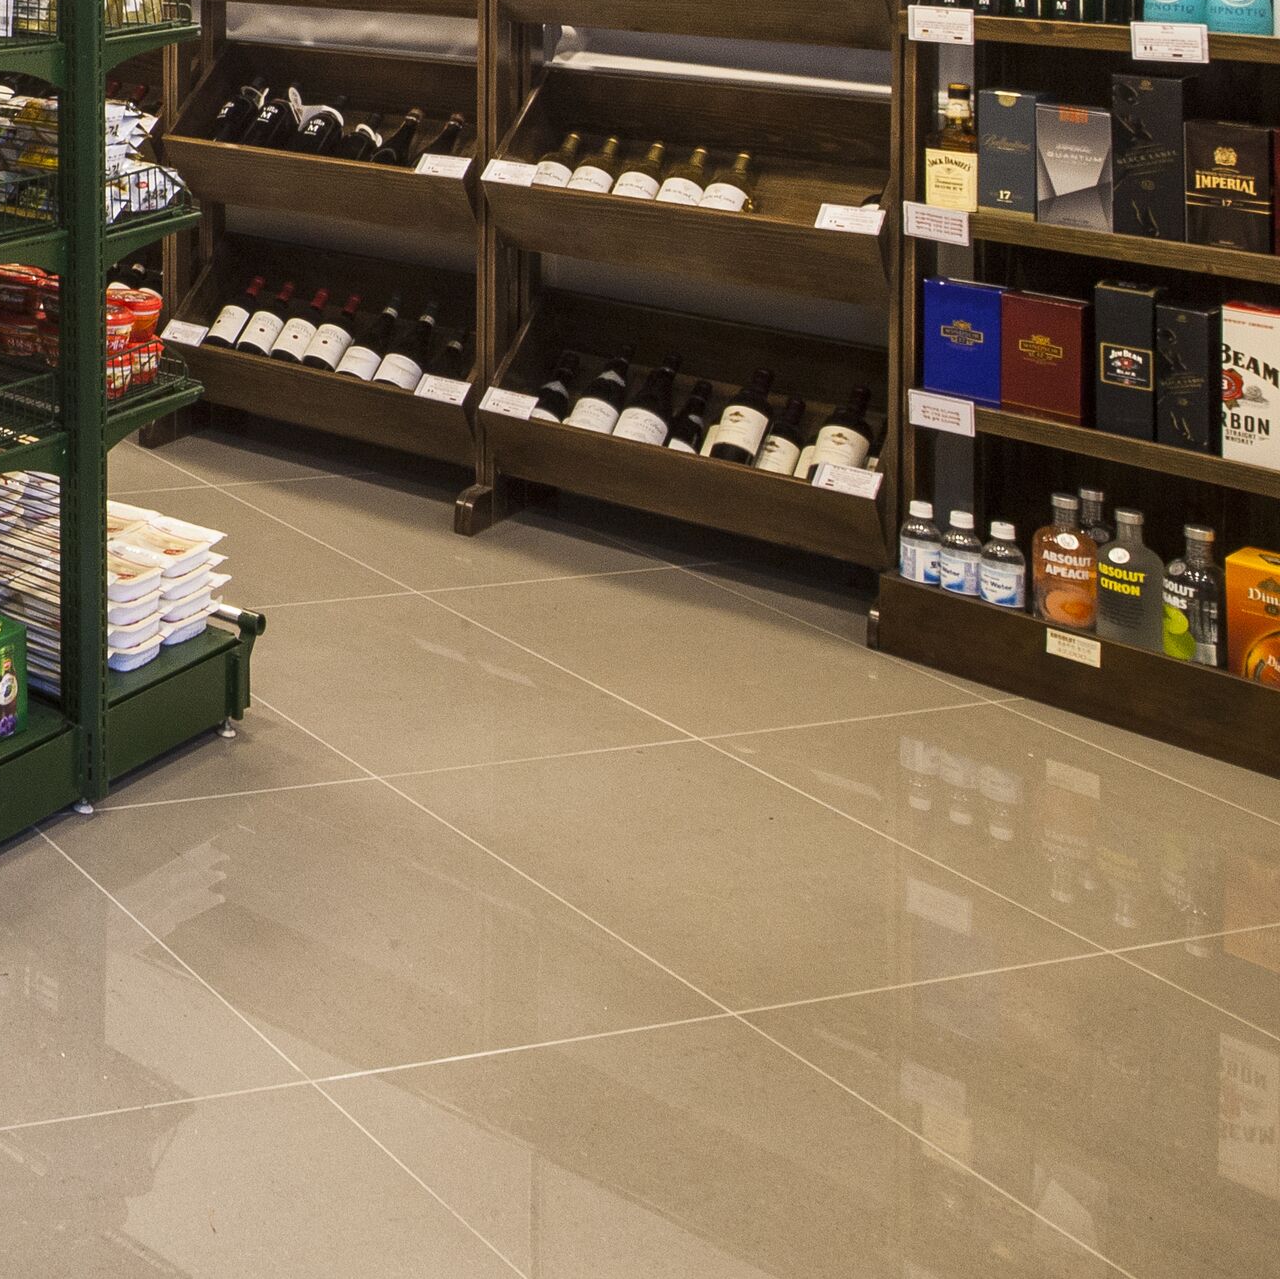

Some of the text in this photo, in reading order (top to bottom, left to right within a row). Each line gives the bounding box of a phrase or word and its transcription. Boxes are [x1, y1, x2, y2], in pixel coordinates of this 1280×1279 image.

[1056, 0, 1068, 11] M
[260, 111, 270, 120] M
[307, 124, 319, 133] M
[1046, 151, 1104, 163] QUANTUM
[927, 157, 972, 172] JACK DANIEL'S
[1195, 173, 1257, 197] IMPERIAL
[999, 190, 1011, 201] 17
[1221, 199, 1233, 208] 17
[1221, 344, 1280, 388] BEAM
[1225, 428, 1257, 440] STRAIGHT
[1225, 435, 1254, 446] WHISKEY
[1042, 549, 1092, 568] ABSOLUT
[1046, 564, 1089, 581] APEACH
[1098, 562, 1146, 584] ABSOLUT
[990, 581, 1013, 593] Water
[1100, 576, 1141, 597] CITRON
